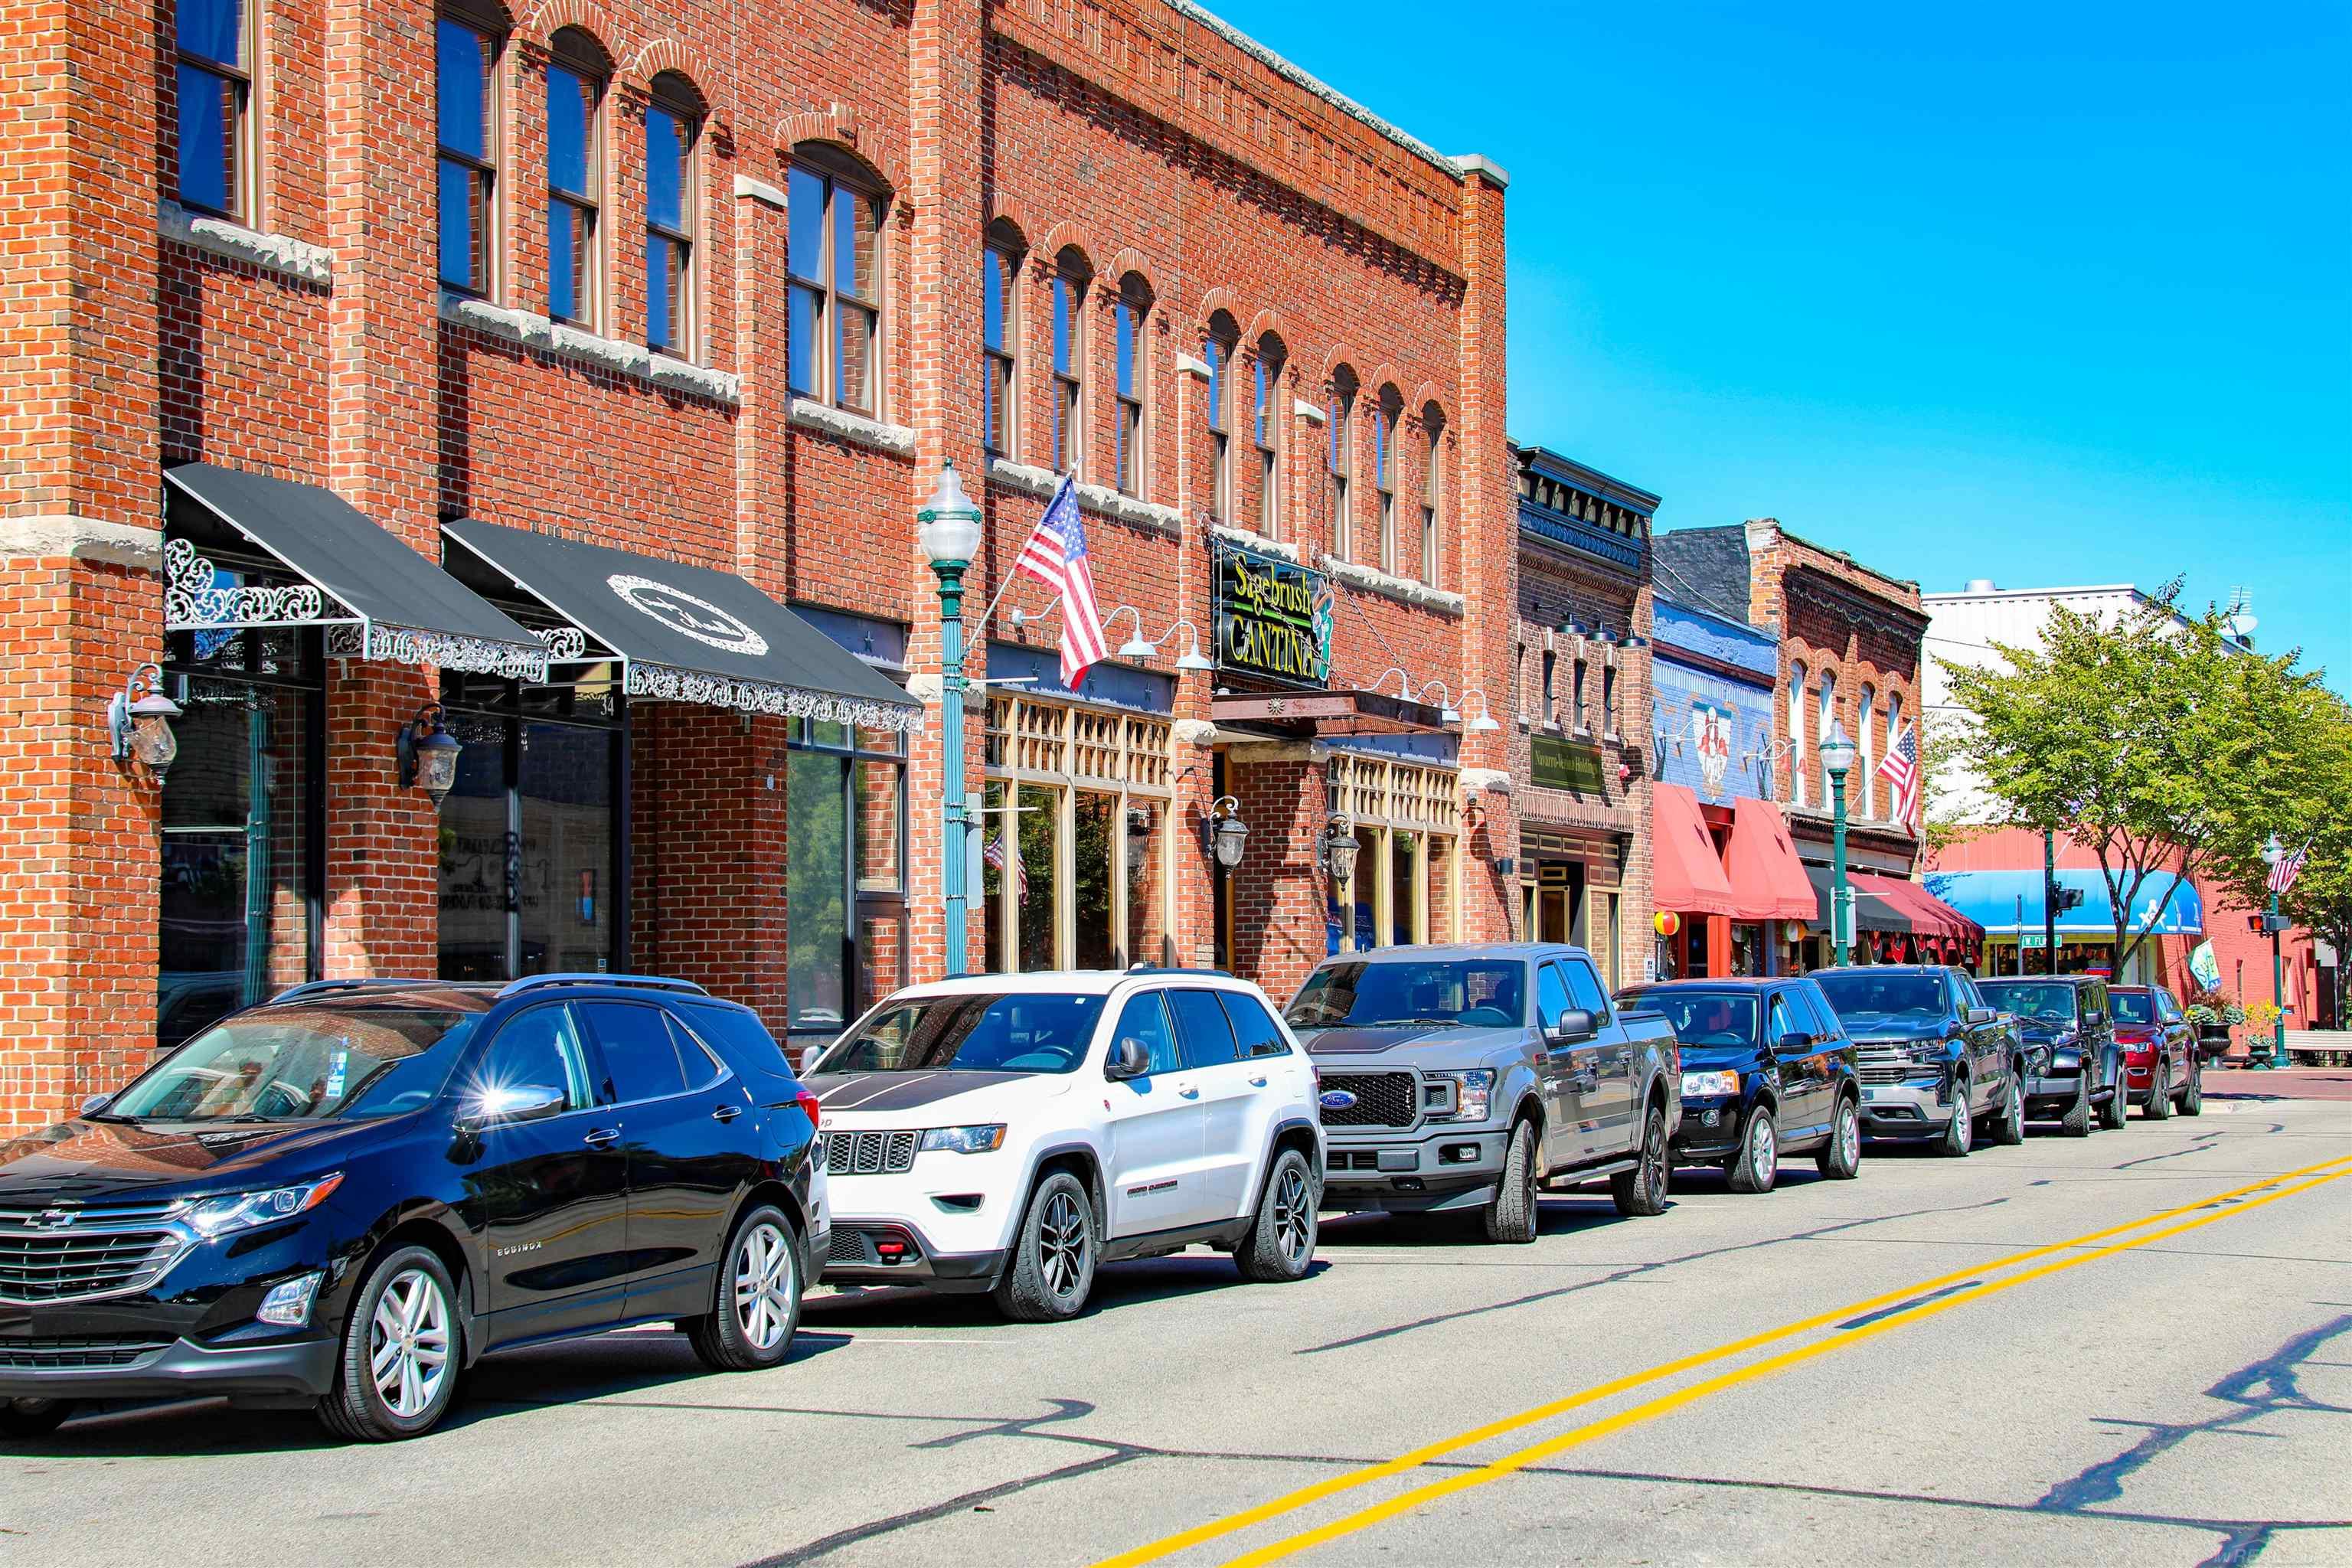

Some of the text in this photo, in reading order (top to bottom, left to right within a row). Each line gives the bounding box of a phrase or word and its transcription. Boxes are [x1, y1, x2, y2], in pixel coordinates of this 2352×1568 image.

[1234, 553, 1311, 616] Sagebrush
[1230, 614, 1316, 678] CANTINA
[600, 696, 614, 717] 34
[497, 1241, 542, 1256] EQUINOX
